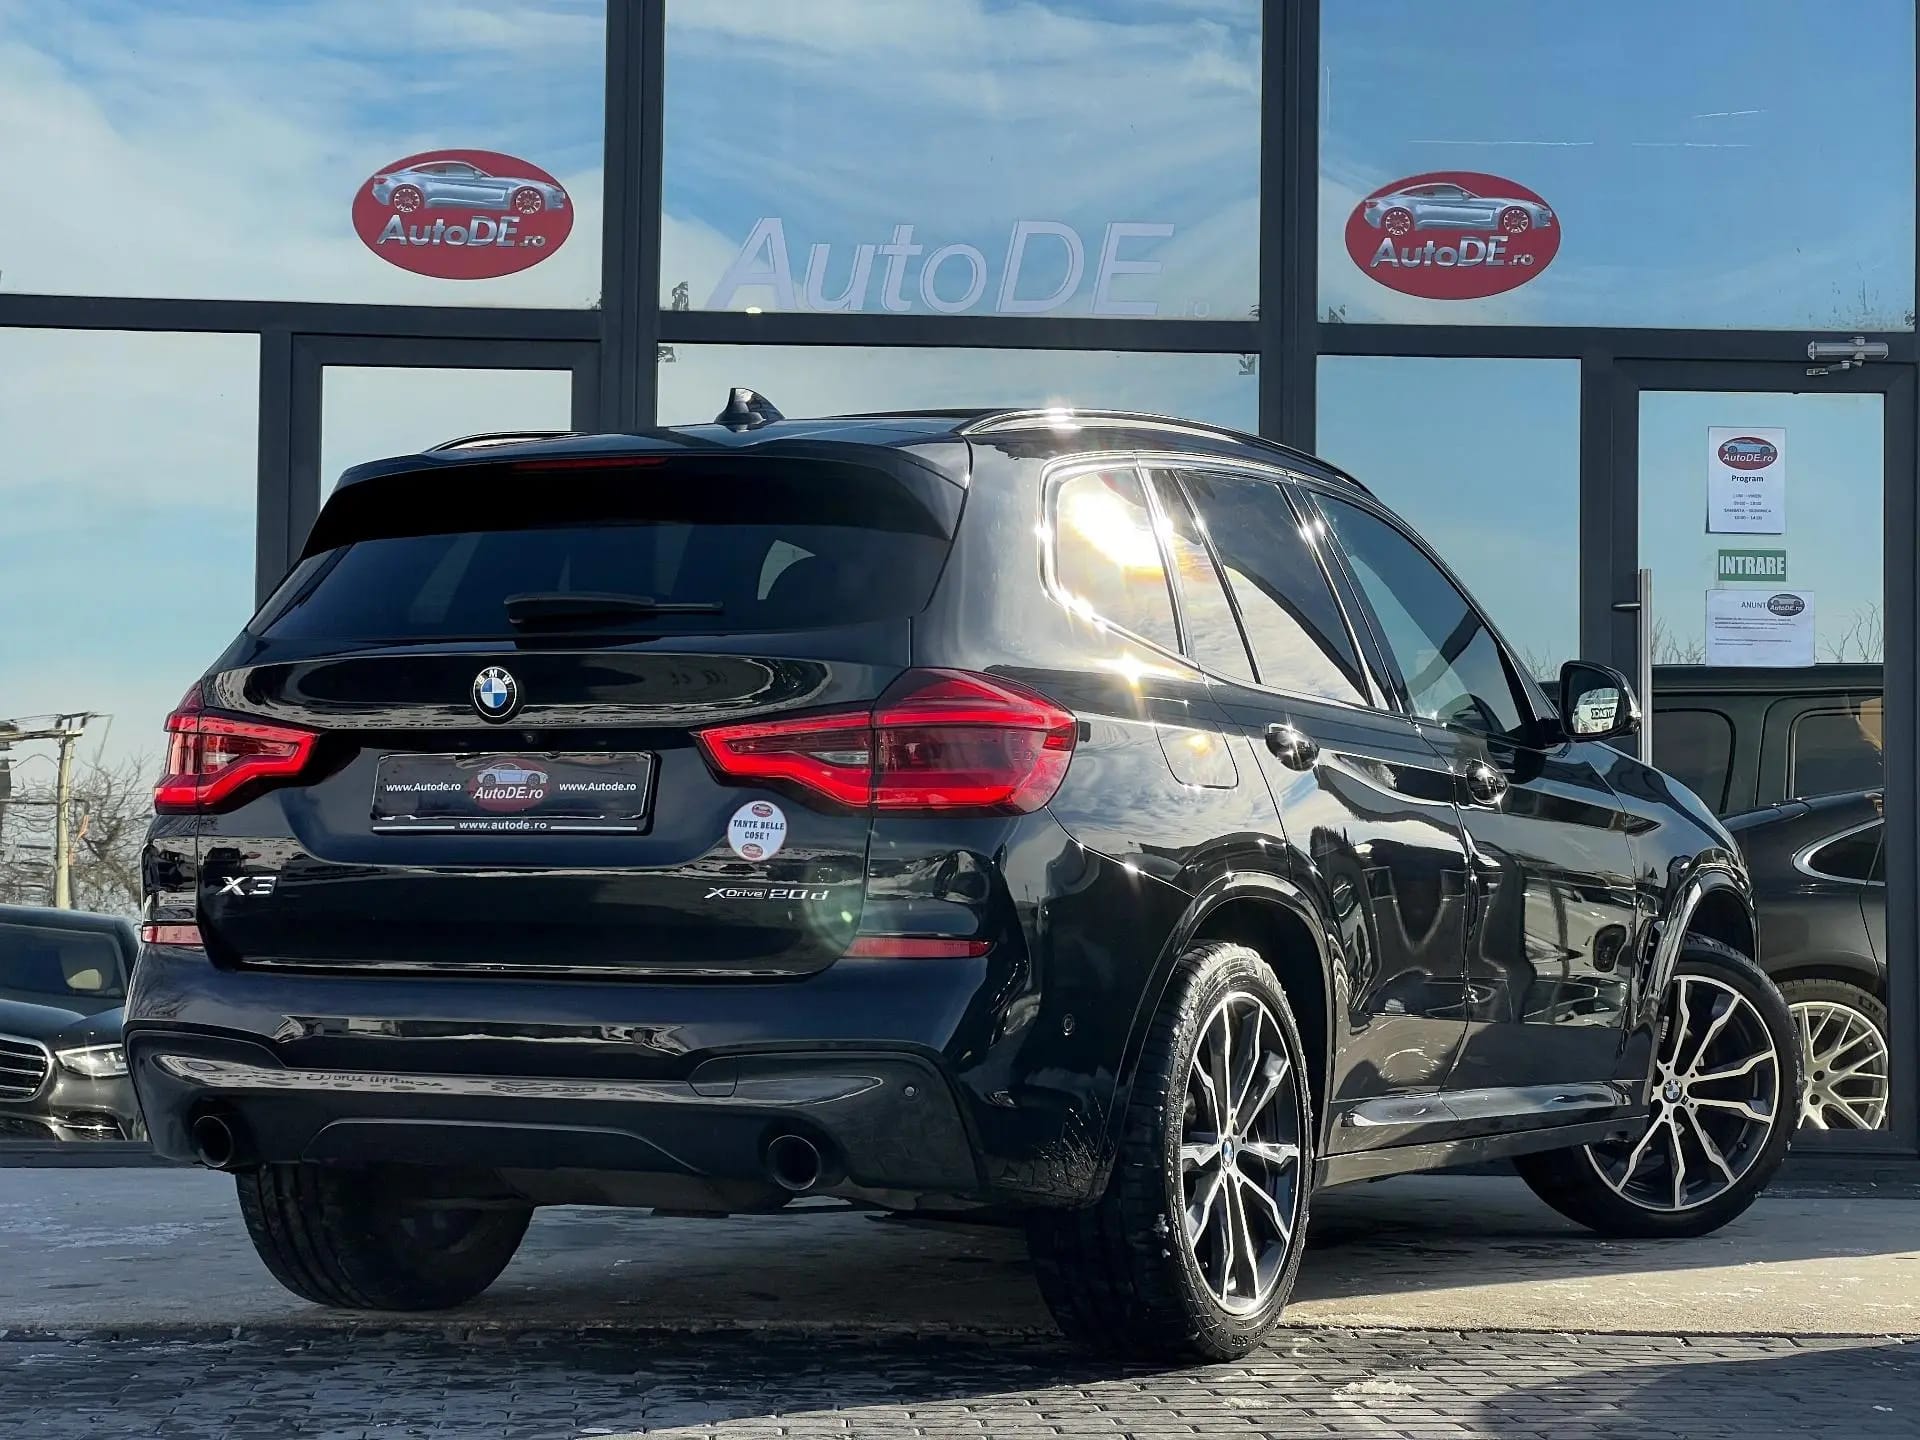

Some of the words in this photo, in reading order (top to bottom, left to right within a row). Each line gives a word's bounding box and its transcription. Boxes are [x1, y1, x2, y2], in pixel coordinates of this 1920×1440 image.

[1722, 453, 1774, 462] AutoDE.ro
[1731, 475, 1764, 483] Program
[1720, 555, 1785, 574] INTRARE
[476, 669, 513, 685] BMW
[386, 782, 461, 793] www.Autode.ro
[473, 786, 544, 800] AutoDE.ro
[559, 781, 637, 792] www.Autode.ro
[459, 820, 547, 830] www.autode.ro
[733, 819, 758, 829] TANTE
[760, 821, 785, 831] BELLE
[744, 831, 765, 840] COSE
[216, 876, 277, 895] X3
[769, 889, 830, 900] 20d
